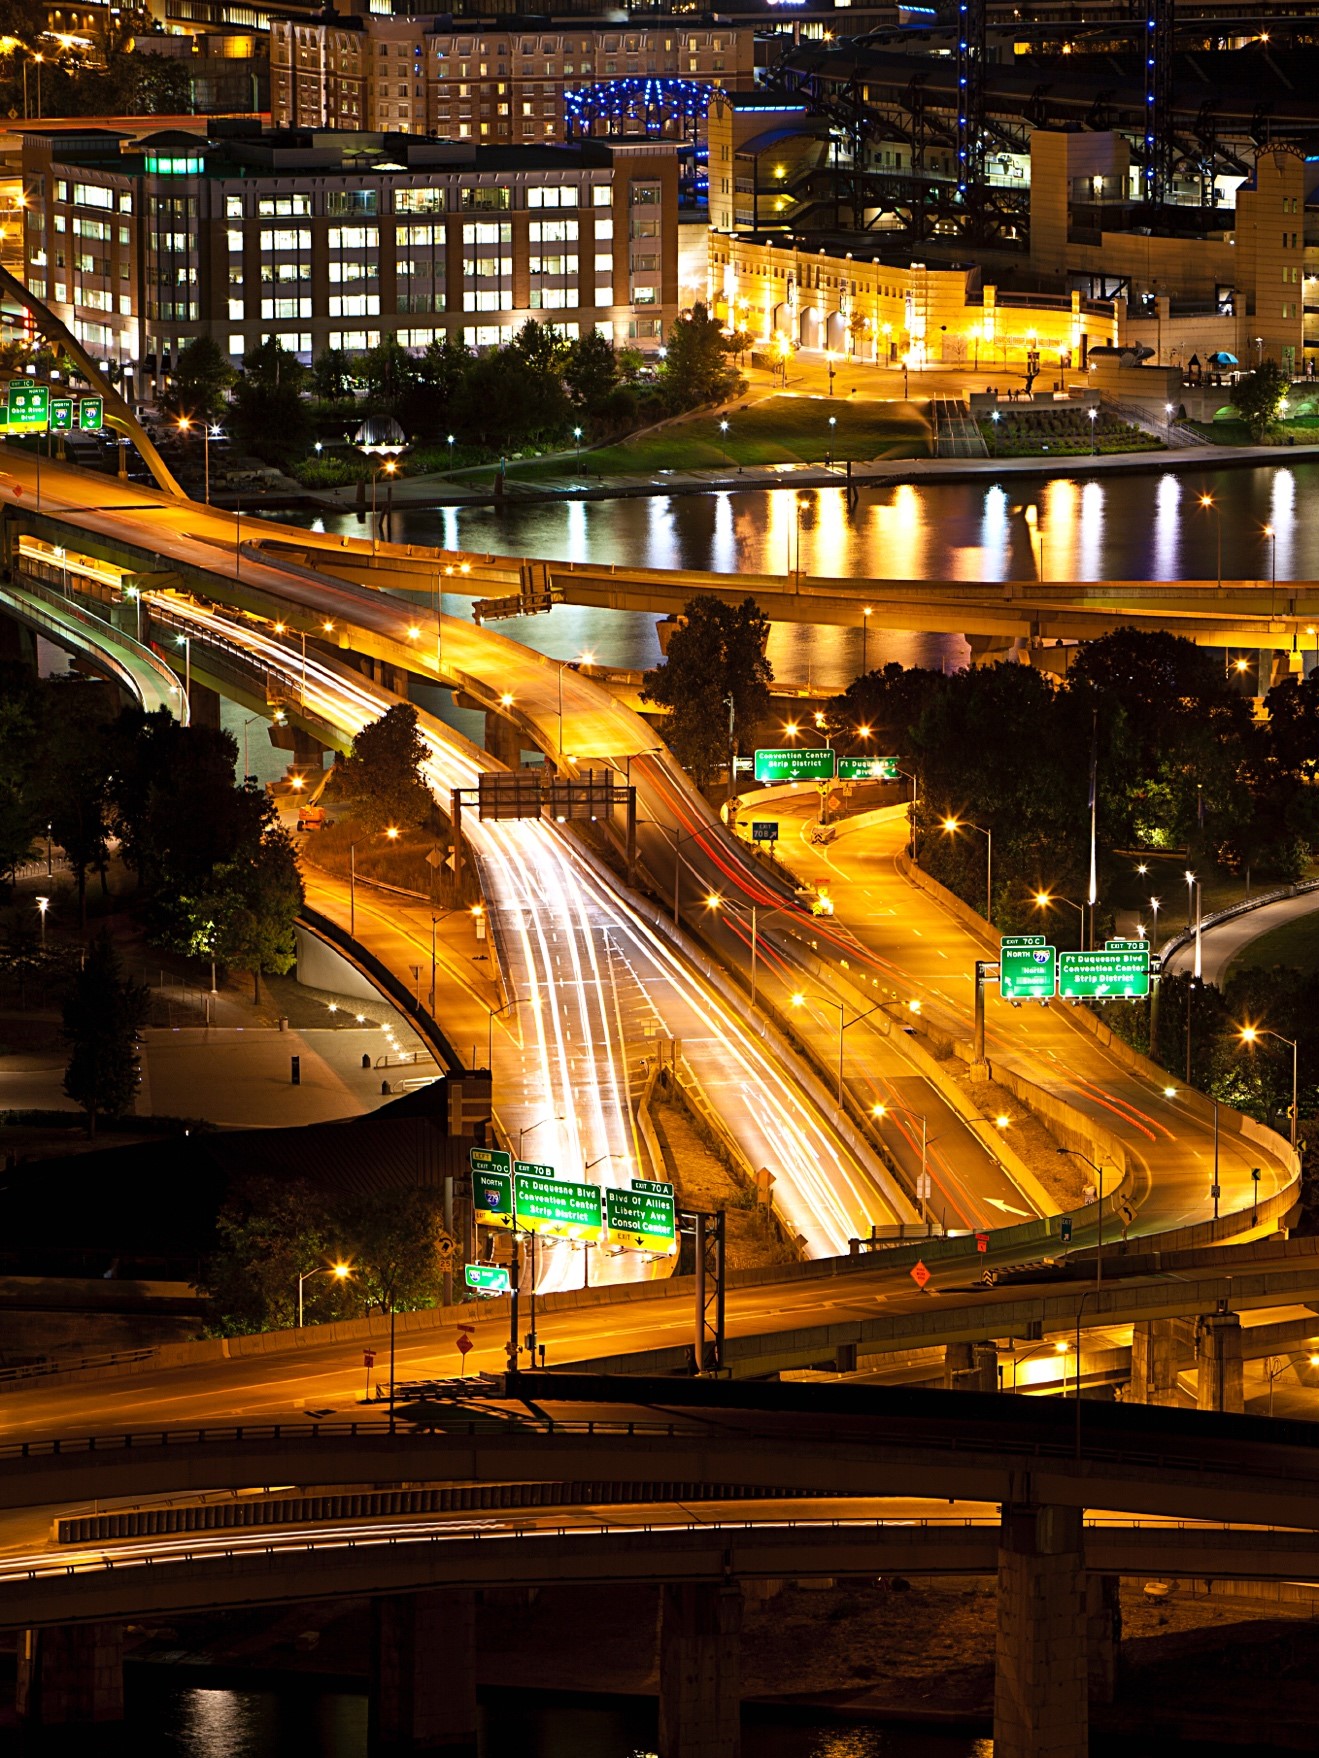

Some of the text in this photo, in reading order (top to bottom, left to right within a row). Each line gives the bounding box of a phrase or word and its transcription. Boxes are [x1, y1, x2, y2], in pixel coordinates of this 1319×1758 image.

[1074, 974, 1134, 983] Strip District
[481, 1177, 503, 1187] NORTH
[520, 1180, 596, 1198] Ft Duquesne Blvd
[519, 1191, 597, 1210] Convention Center
[609, 1193, 670, 1210] Blvd Of Allies
[530, 1204, 588, 1221] Strip District
[614, 1205, 666, 1221] Liberty Ave
[612, 1217, 671, 1234] Consol Center
